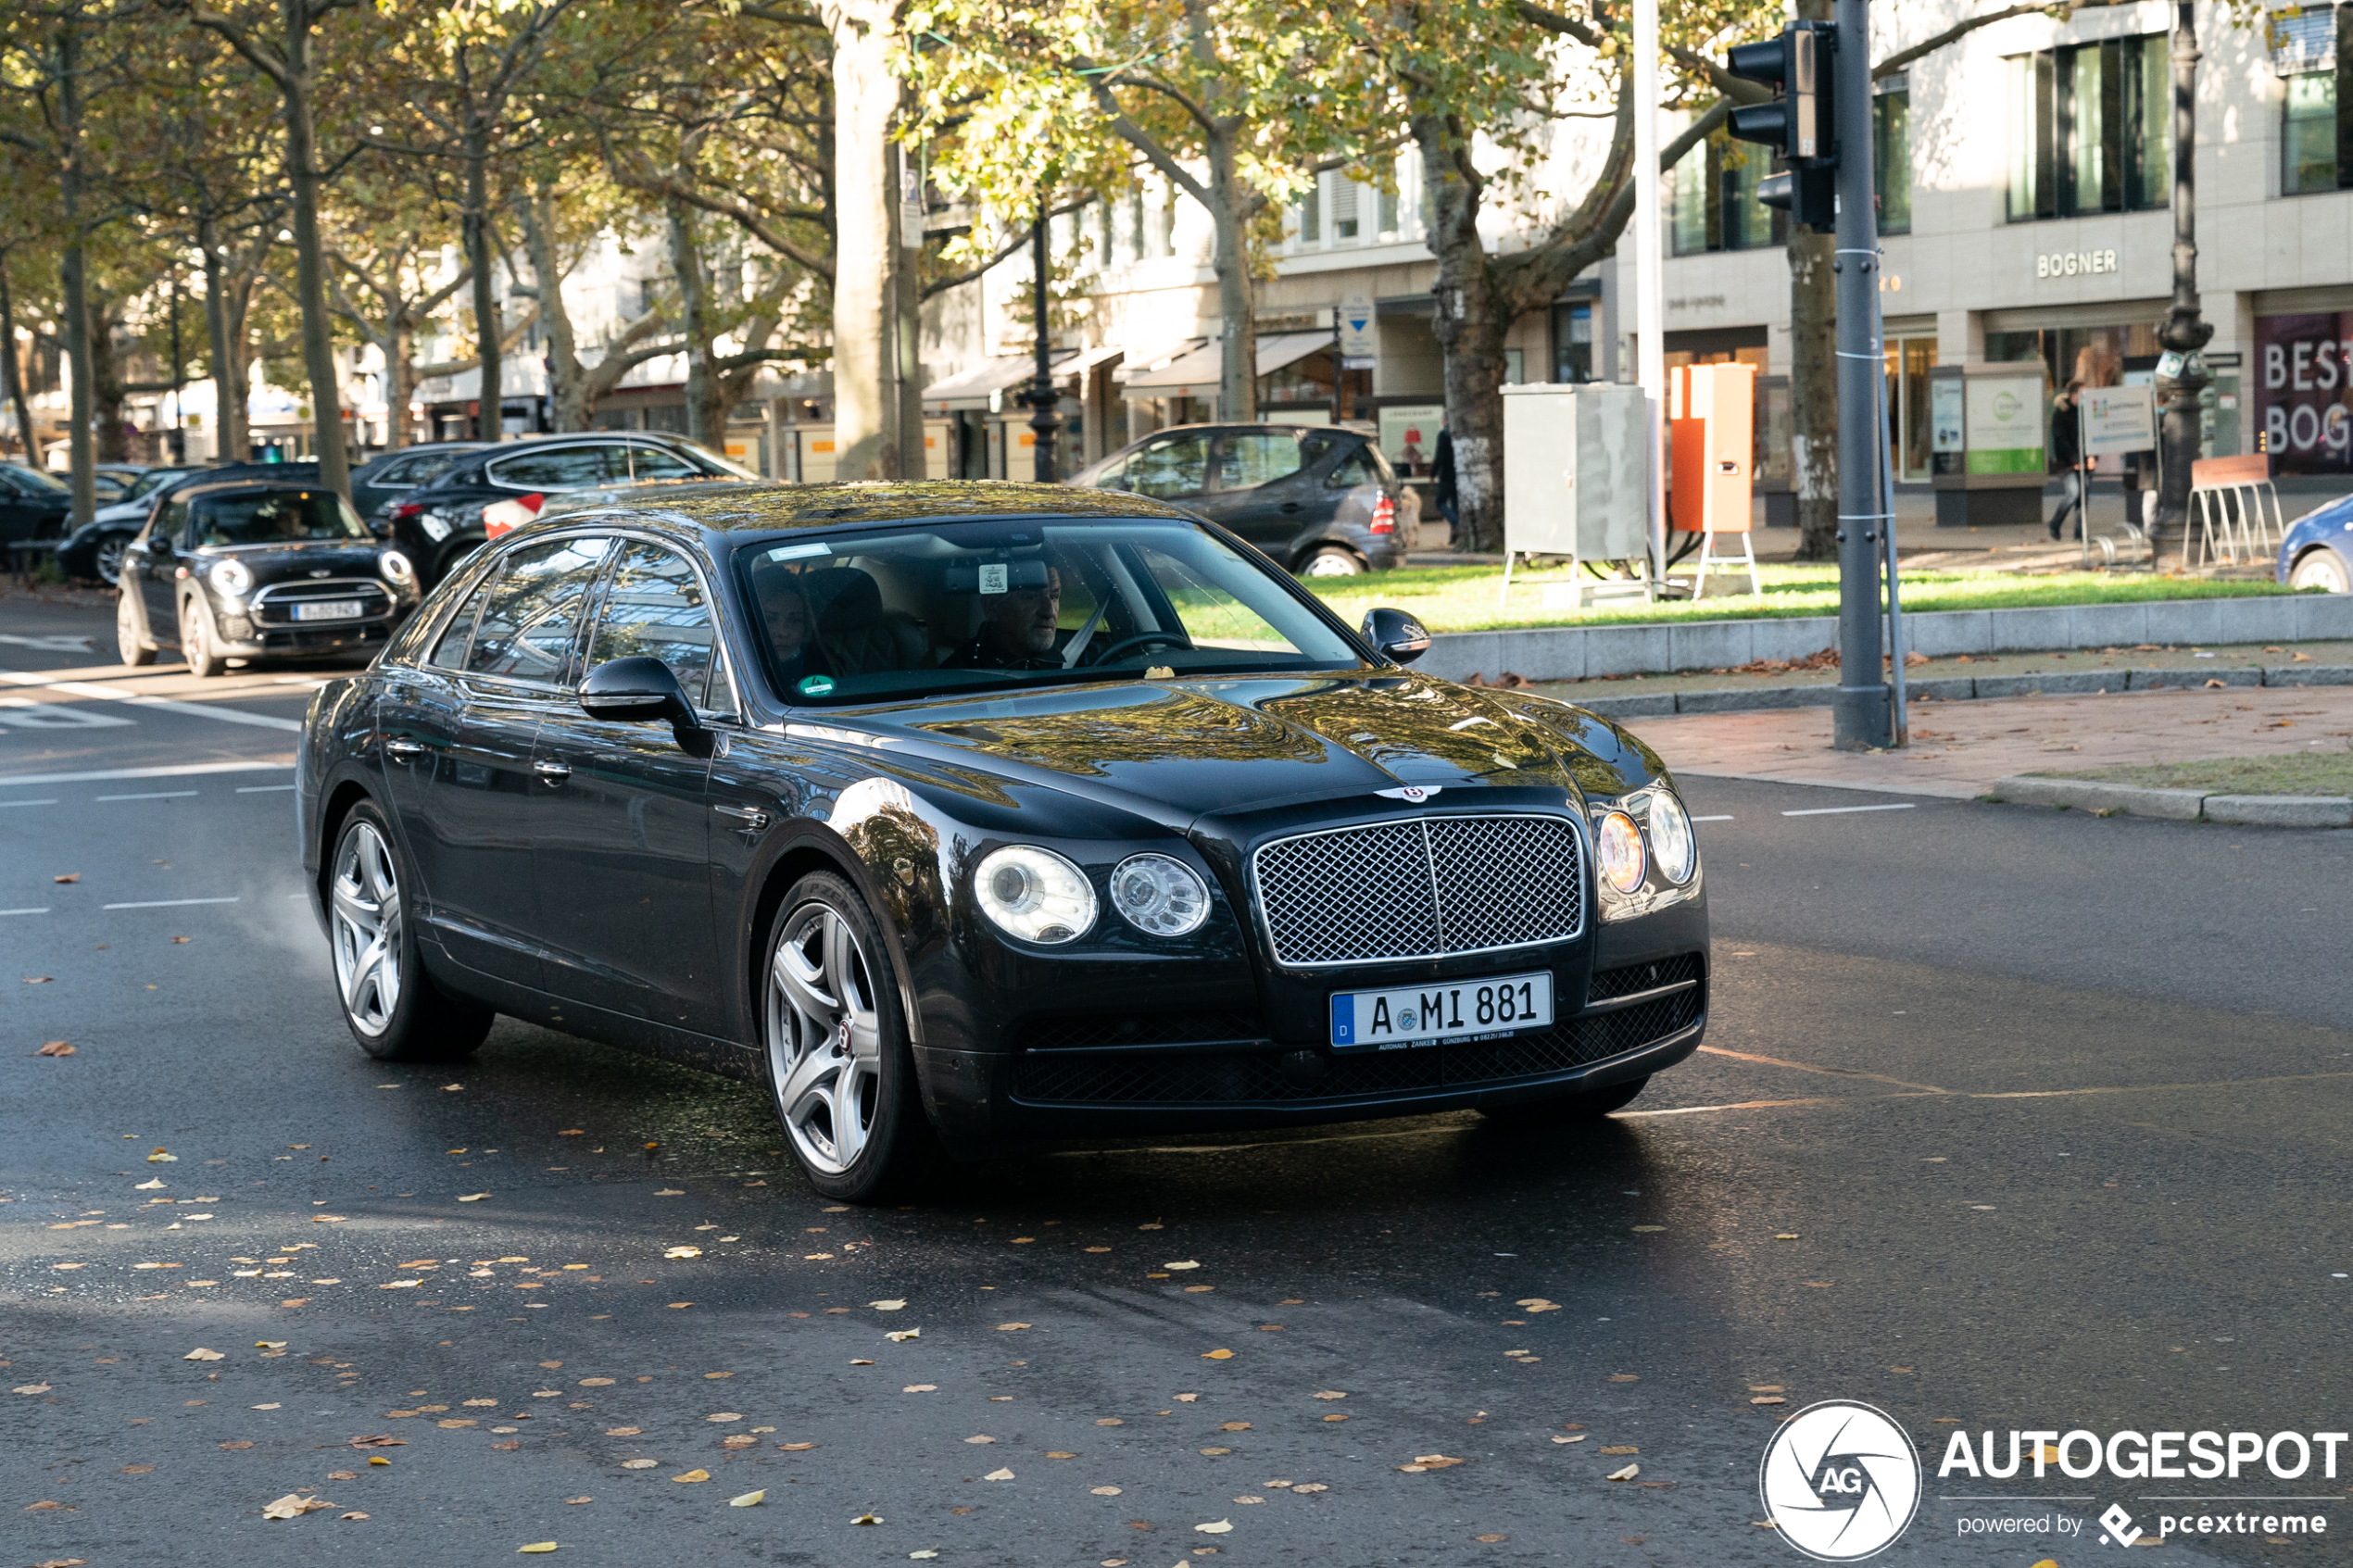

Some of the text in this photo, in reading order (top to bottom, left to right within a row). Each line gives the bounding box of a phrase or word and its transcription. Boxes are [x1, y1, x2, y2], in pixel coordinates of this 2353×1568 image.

[2037, 249, 2117, 278] BOGNER
[2266, 402, 2350, 455] BOG
[1371, 981, 1537, 1035] A MI 881
[1340, 1025, 1348, 1036] D
[1378, 1042, 1407, 1051] AUTOHAUS
